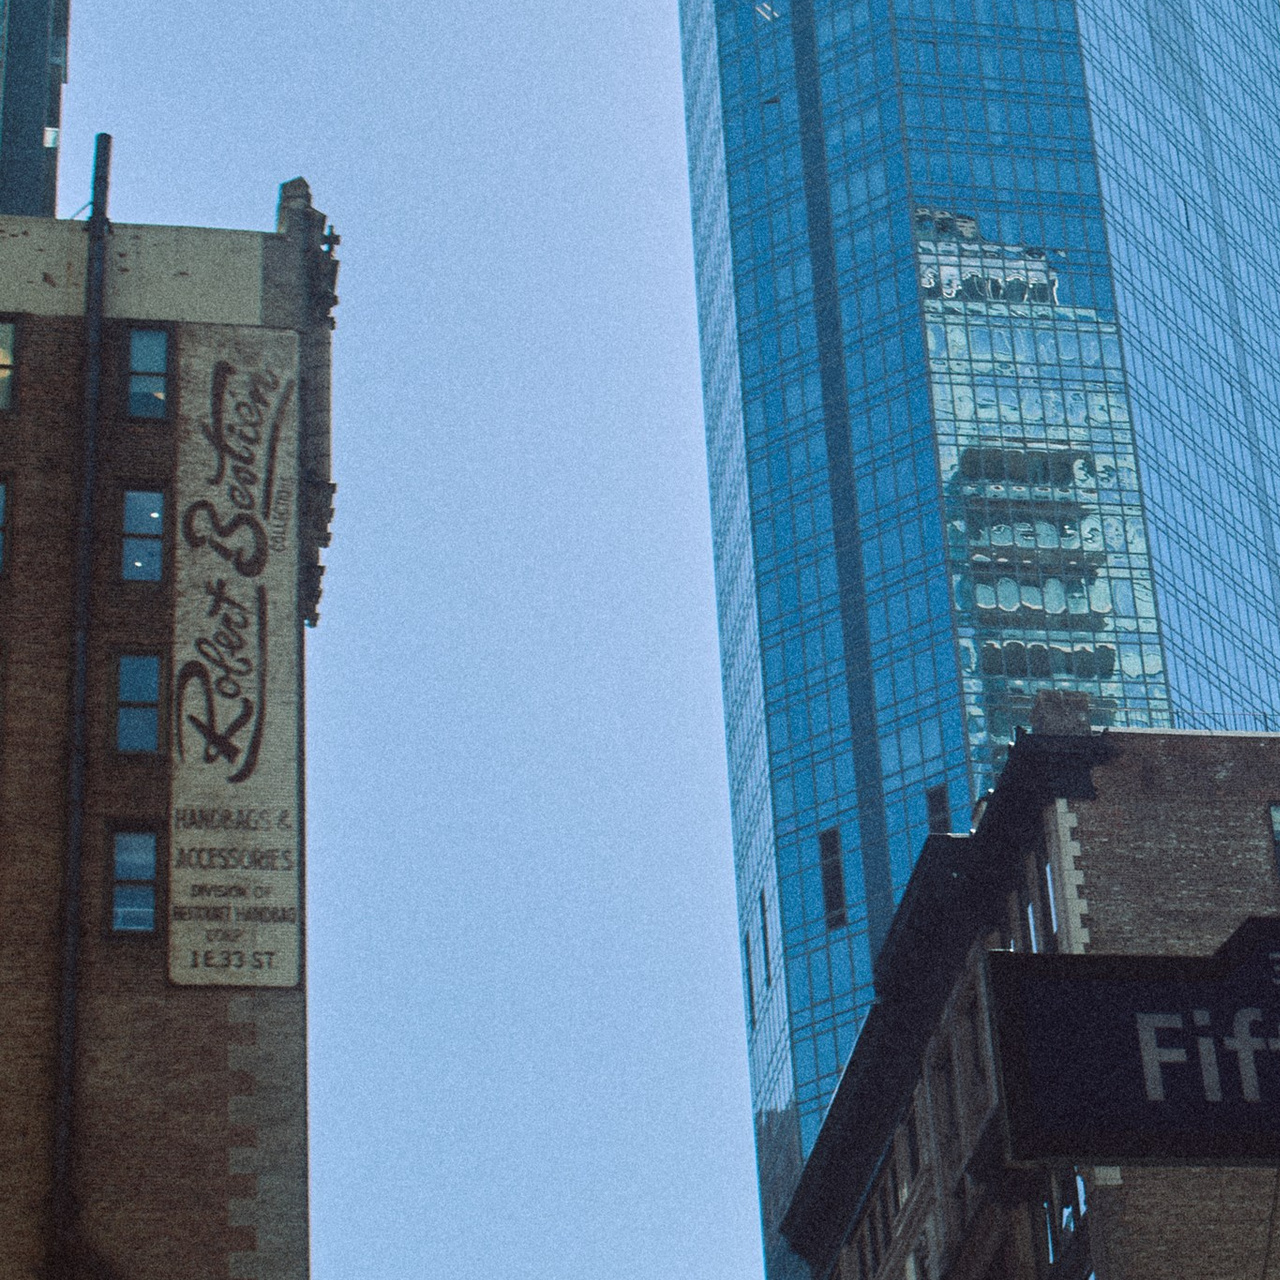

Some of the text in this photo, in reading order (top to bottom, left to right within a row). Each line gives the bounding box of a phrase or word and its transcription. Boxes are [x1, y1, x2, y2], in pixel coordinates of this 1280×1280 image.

[176, 578, 266, 780] Robert
[175, 808, 269, 831] HANDBAGS
[175, 847, 294, 871] ACCESSORIES
